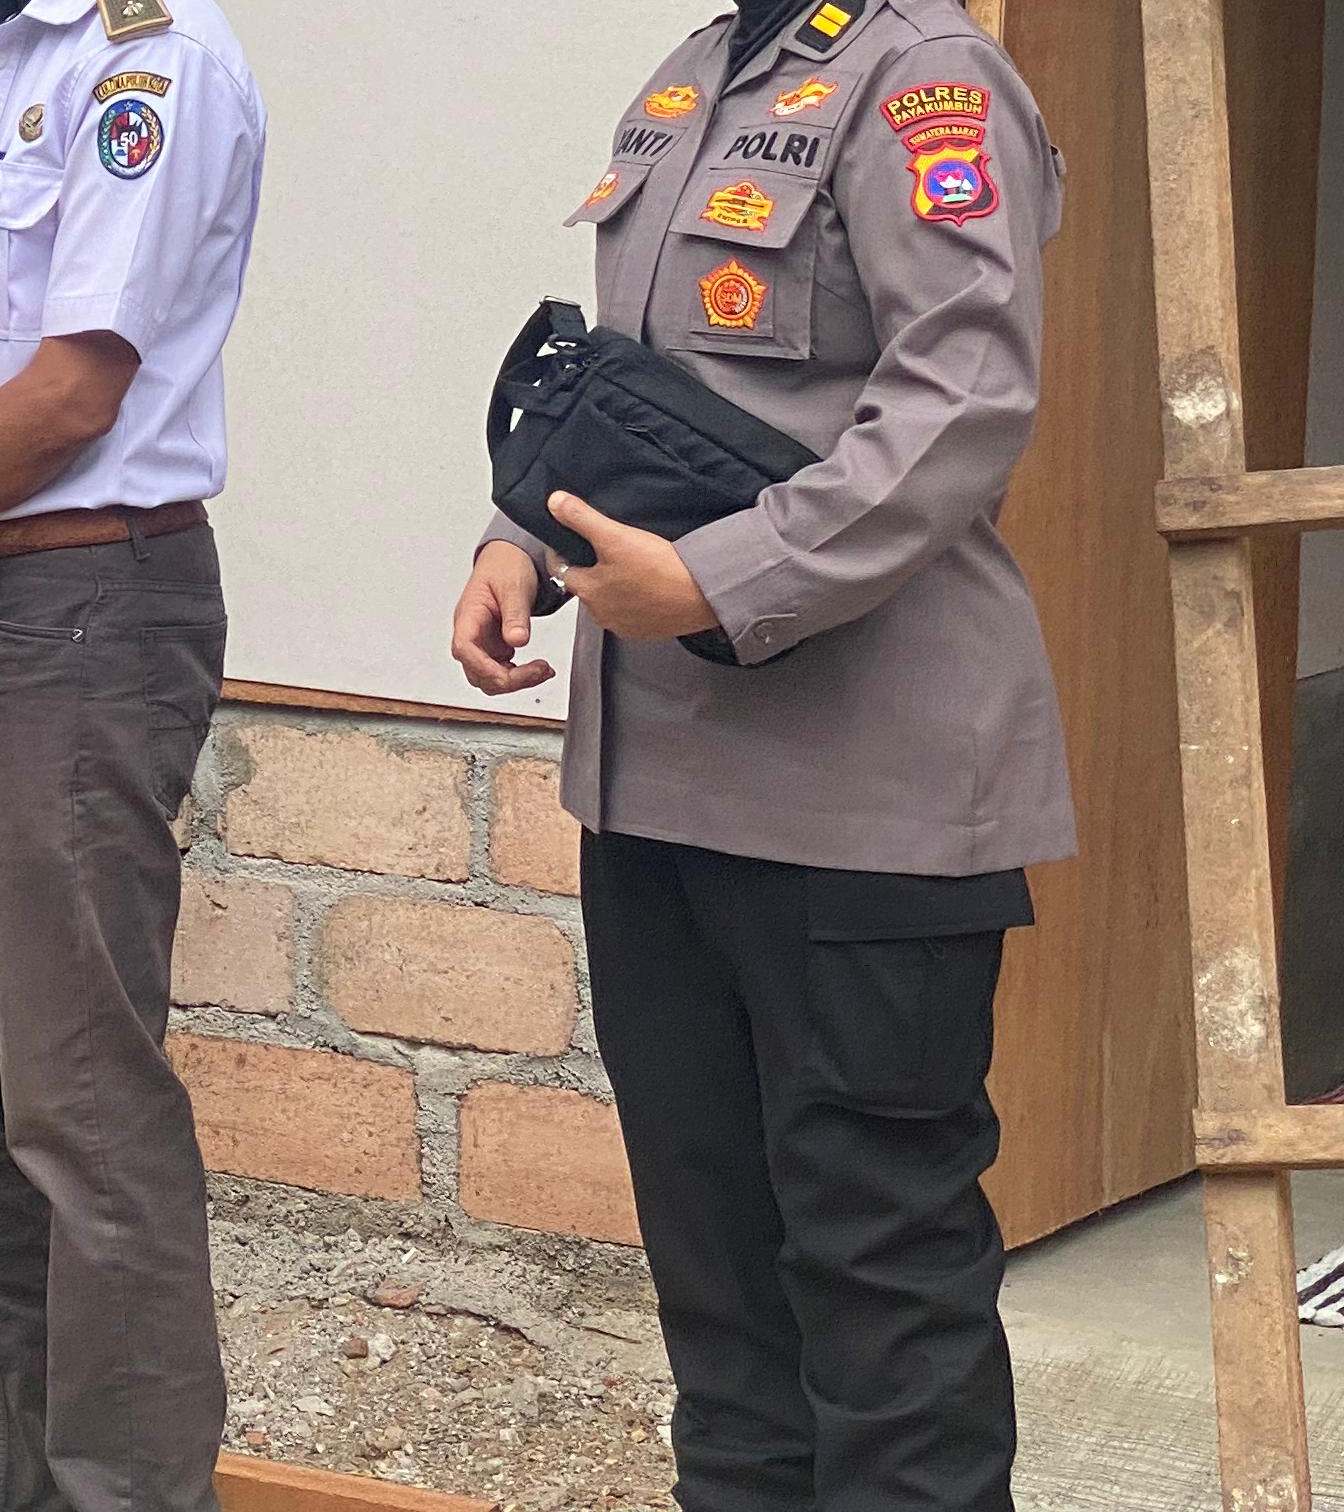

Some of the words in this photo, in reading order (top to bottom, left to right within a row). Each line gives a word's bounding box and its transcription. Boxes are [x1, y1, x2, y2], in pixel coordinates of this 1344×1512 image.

[887, 86, 983, 115] POLRES
[893, 101, 983, 125] PAYAKUMBUH
[120, 131, 138, 147] 50
[723, 131, 820, 168] POLRI
